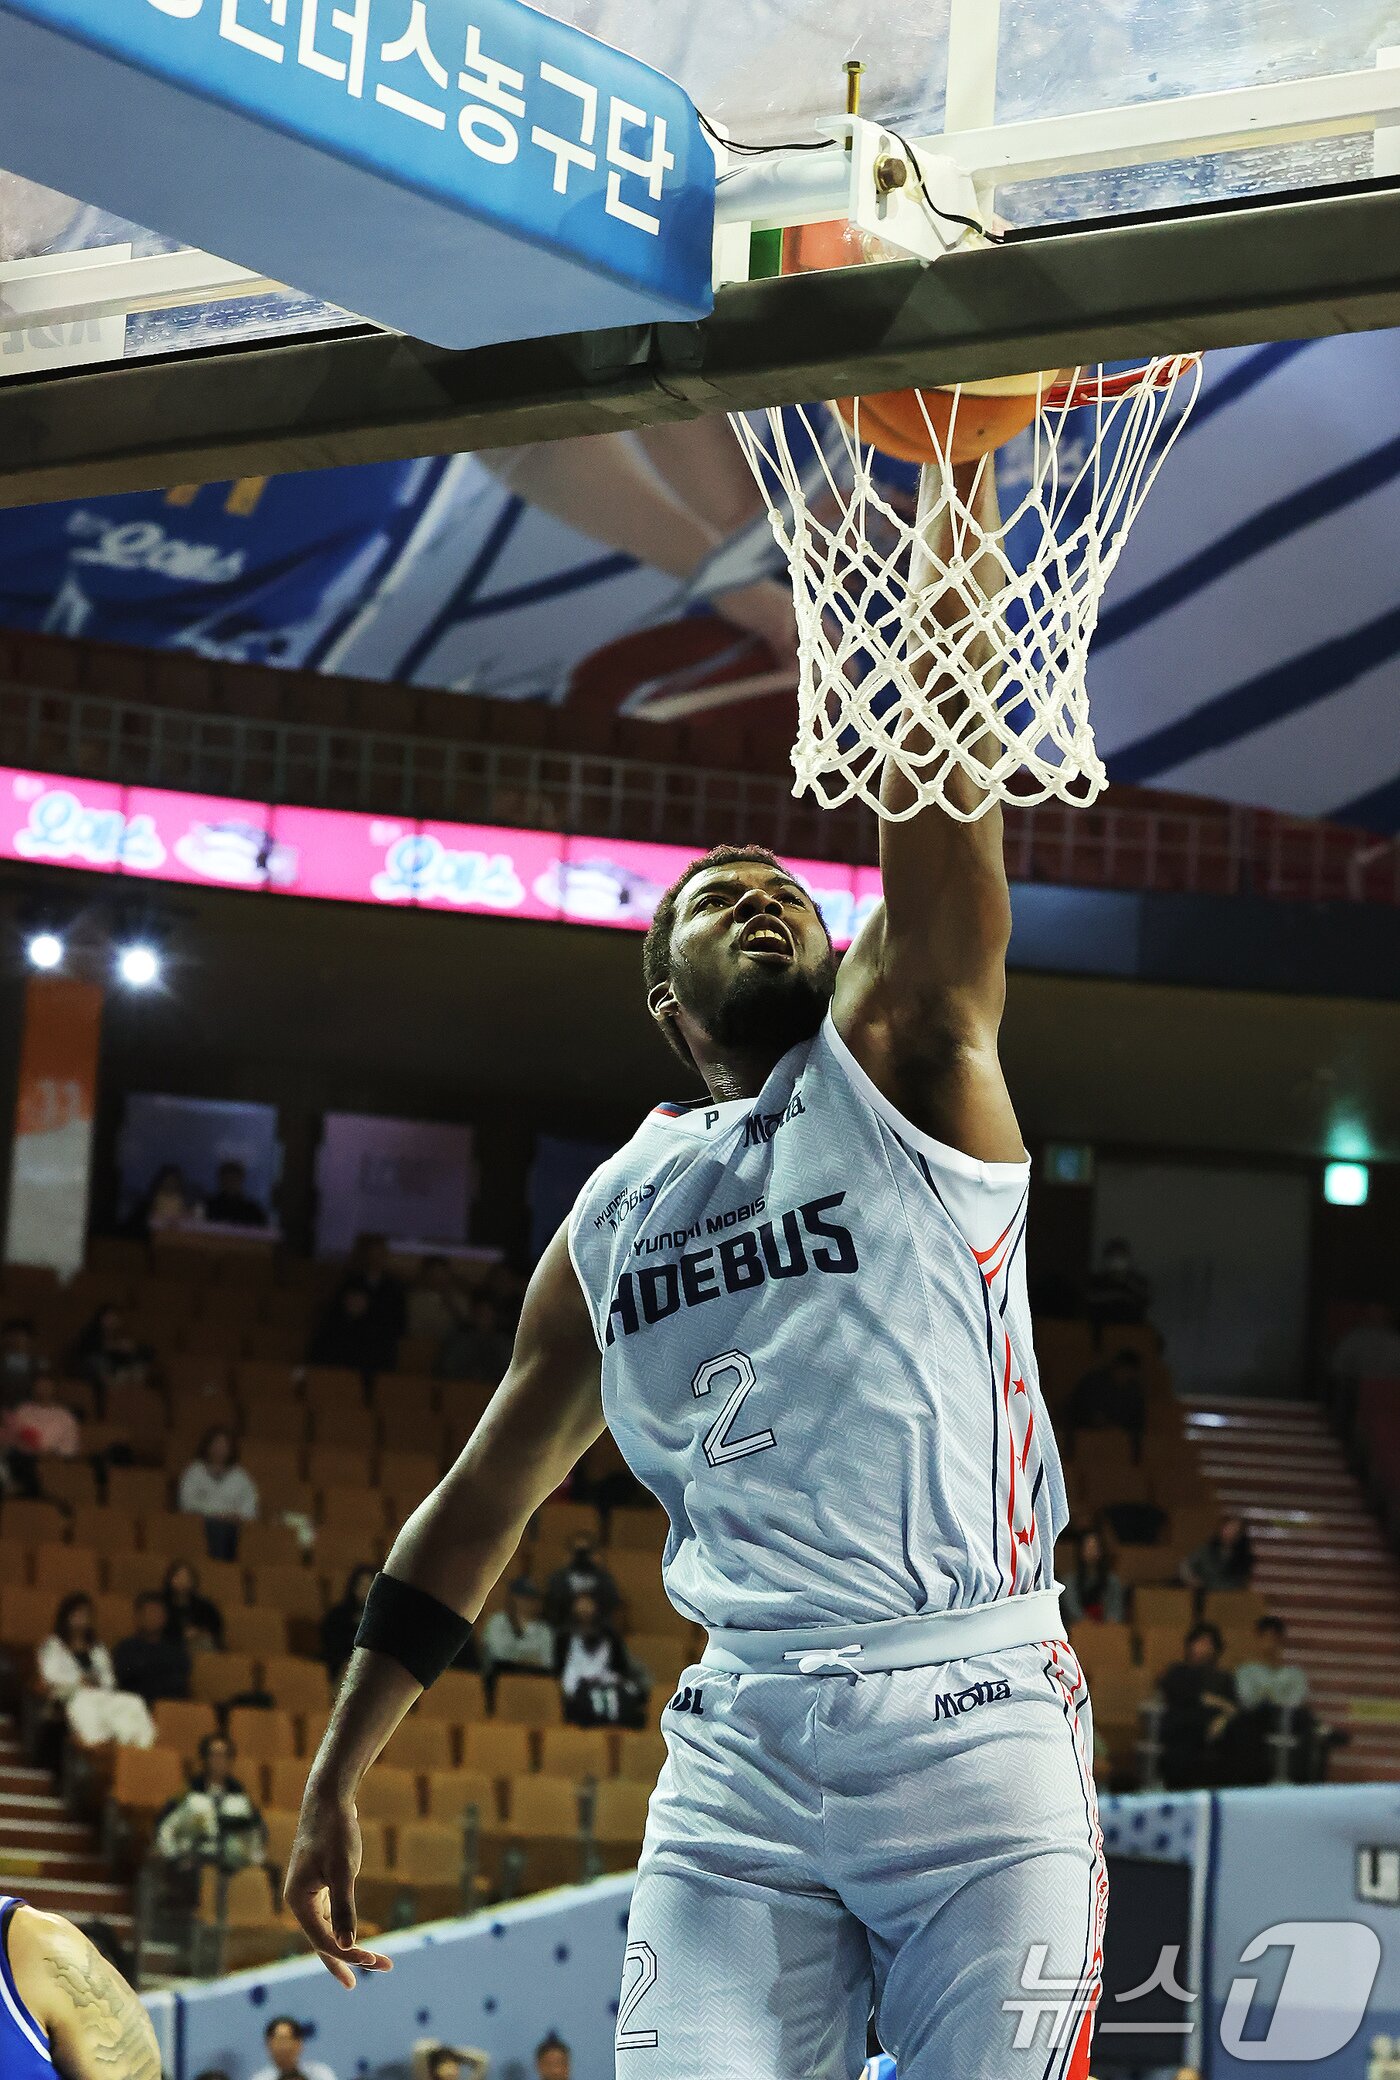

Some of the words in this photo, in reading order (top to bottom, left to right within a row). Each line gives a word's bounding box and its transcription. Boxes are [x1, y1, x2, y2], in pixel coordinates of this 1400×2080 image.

[146, 0, 675, 236] 더스농구단
[704, 1110, 720, 1131] P
[706, 1196, 767, 1234] MOBIS
[691, 1348, 777, 1469] 2
[668, 1686, 704, 1715] BL
[932, 1679, 1012, 1721] Motta
[616, 1940, 659, 2052] 2
